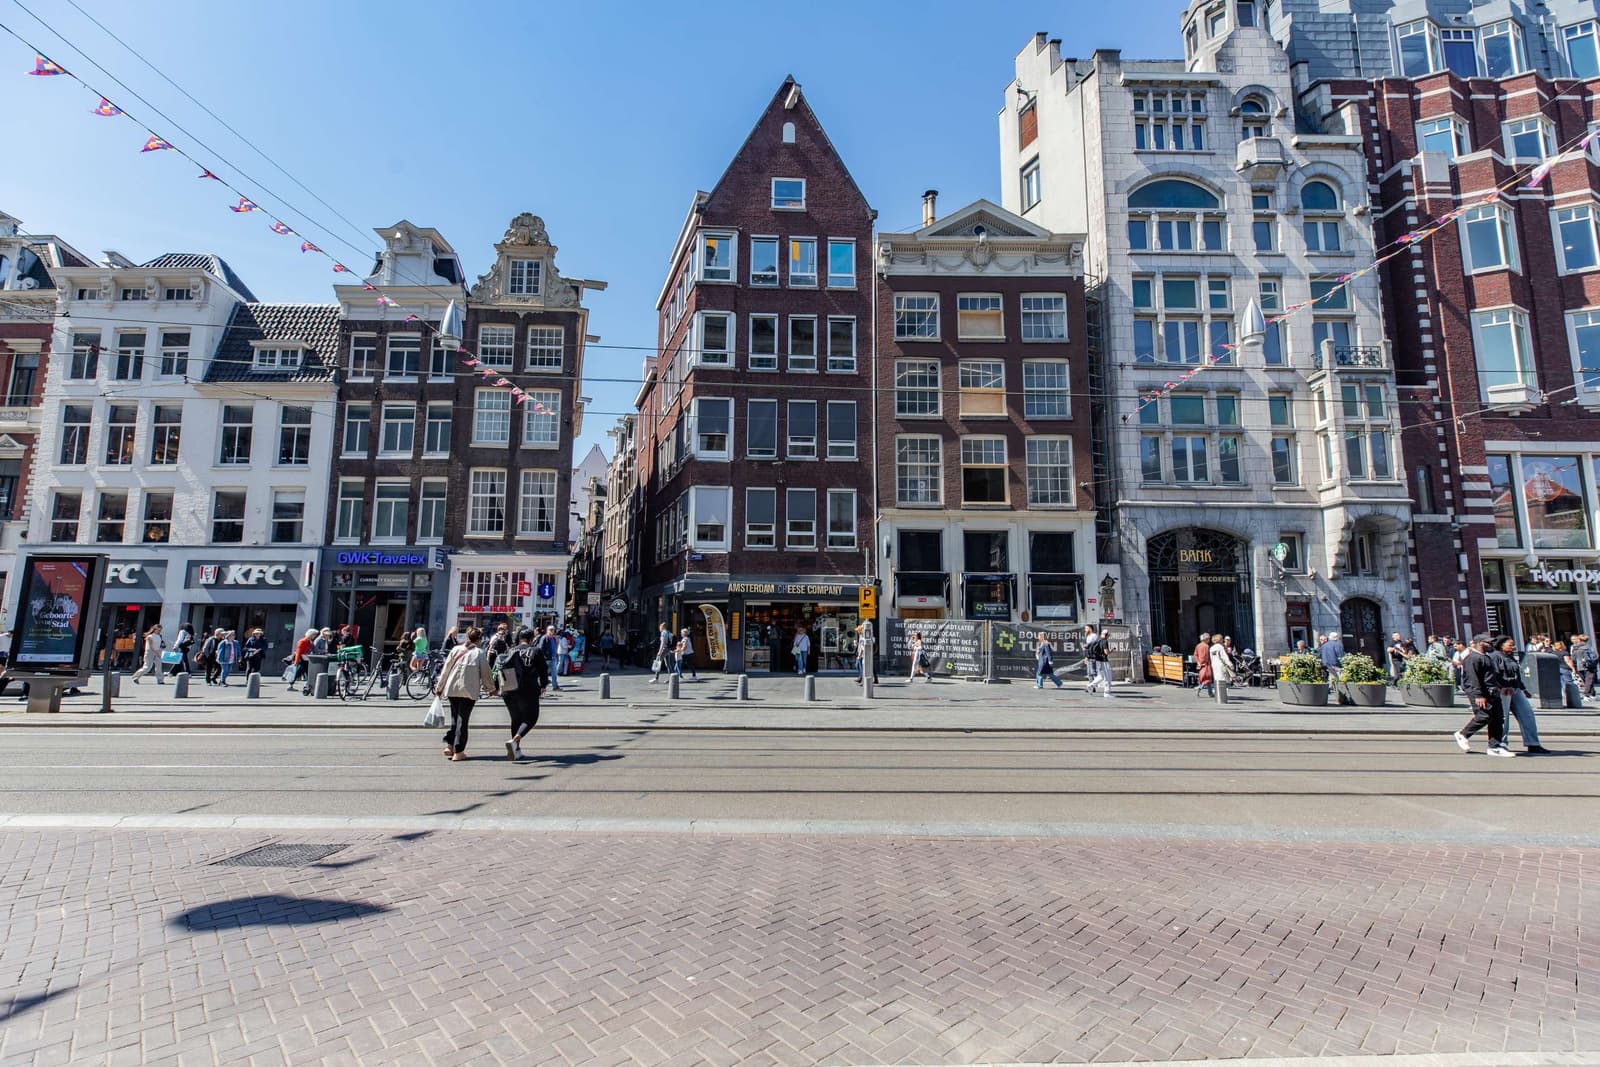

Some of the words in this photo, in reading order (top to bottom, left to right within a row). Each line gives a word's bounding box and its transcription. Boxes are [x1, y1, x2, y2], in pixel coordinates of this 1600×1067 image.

[337, 551, 370, 564] GWK
[375, 551, 425, 564] Travelex
[1180, 549, 1212, 562] BANK
[105, 564, 142, 584] FC
[223, 564, 288, 585] KFC
[728, 583, 775, 594] AMSTERDAM
[777, 583, 806, 595] CHEESE
[807, 584, 843, 596] COMPANY
[863, 589, 872, 600] P
[40, 611, 74, 619] Geboorte
[51, 620, 69, 628] Stad
[1018, 641, 1058, 652] TUN
